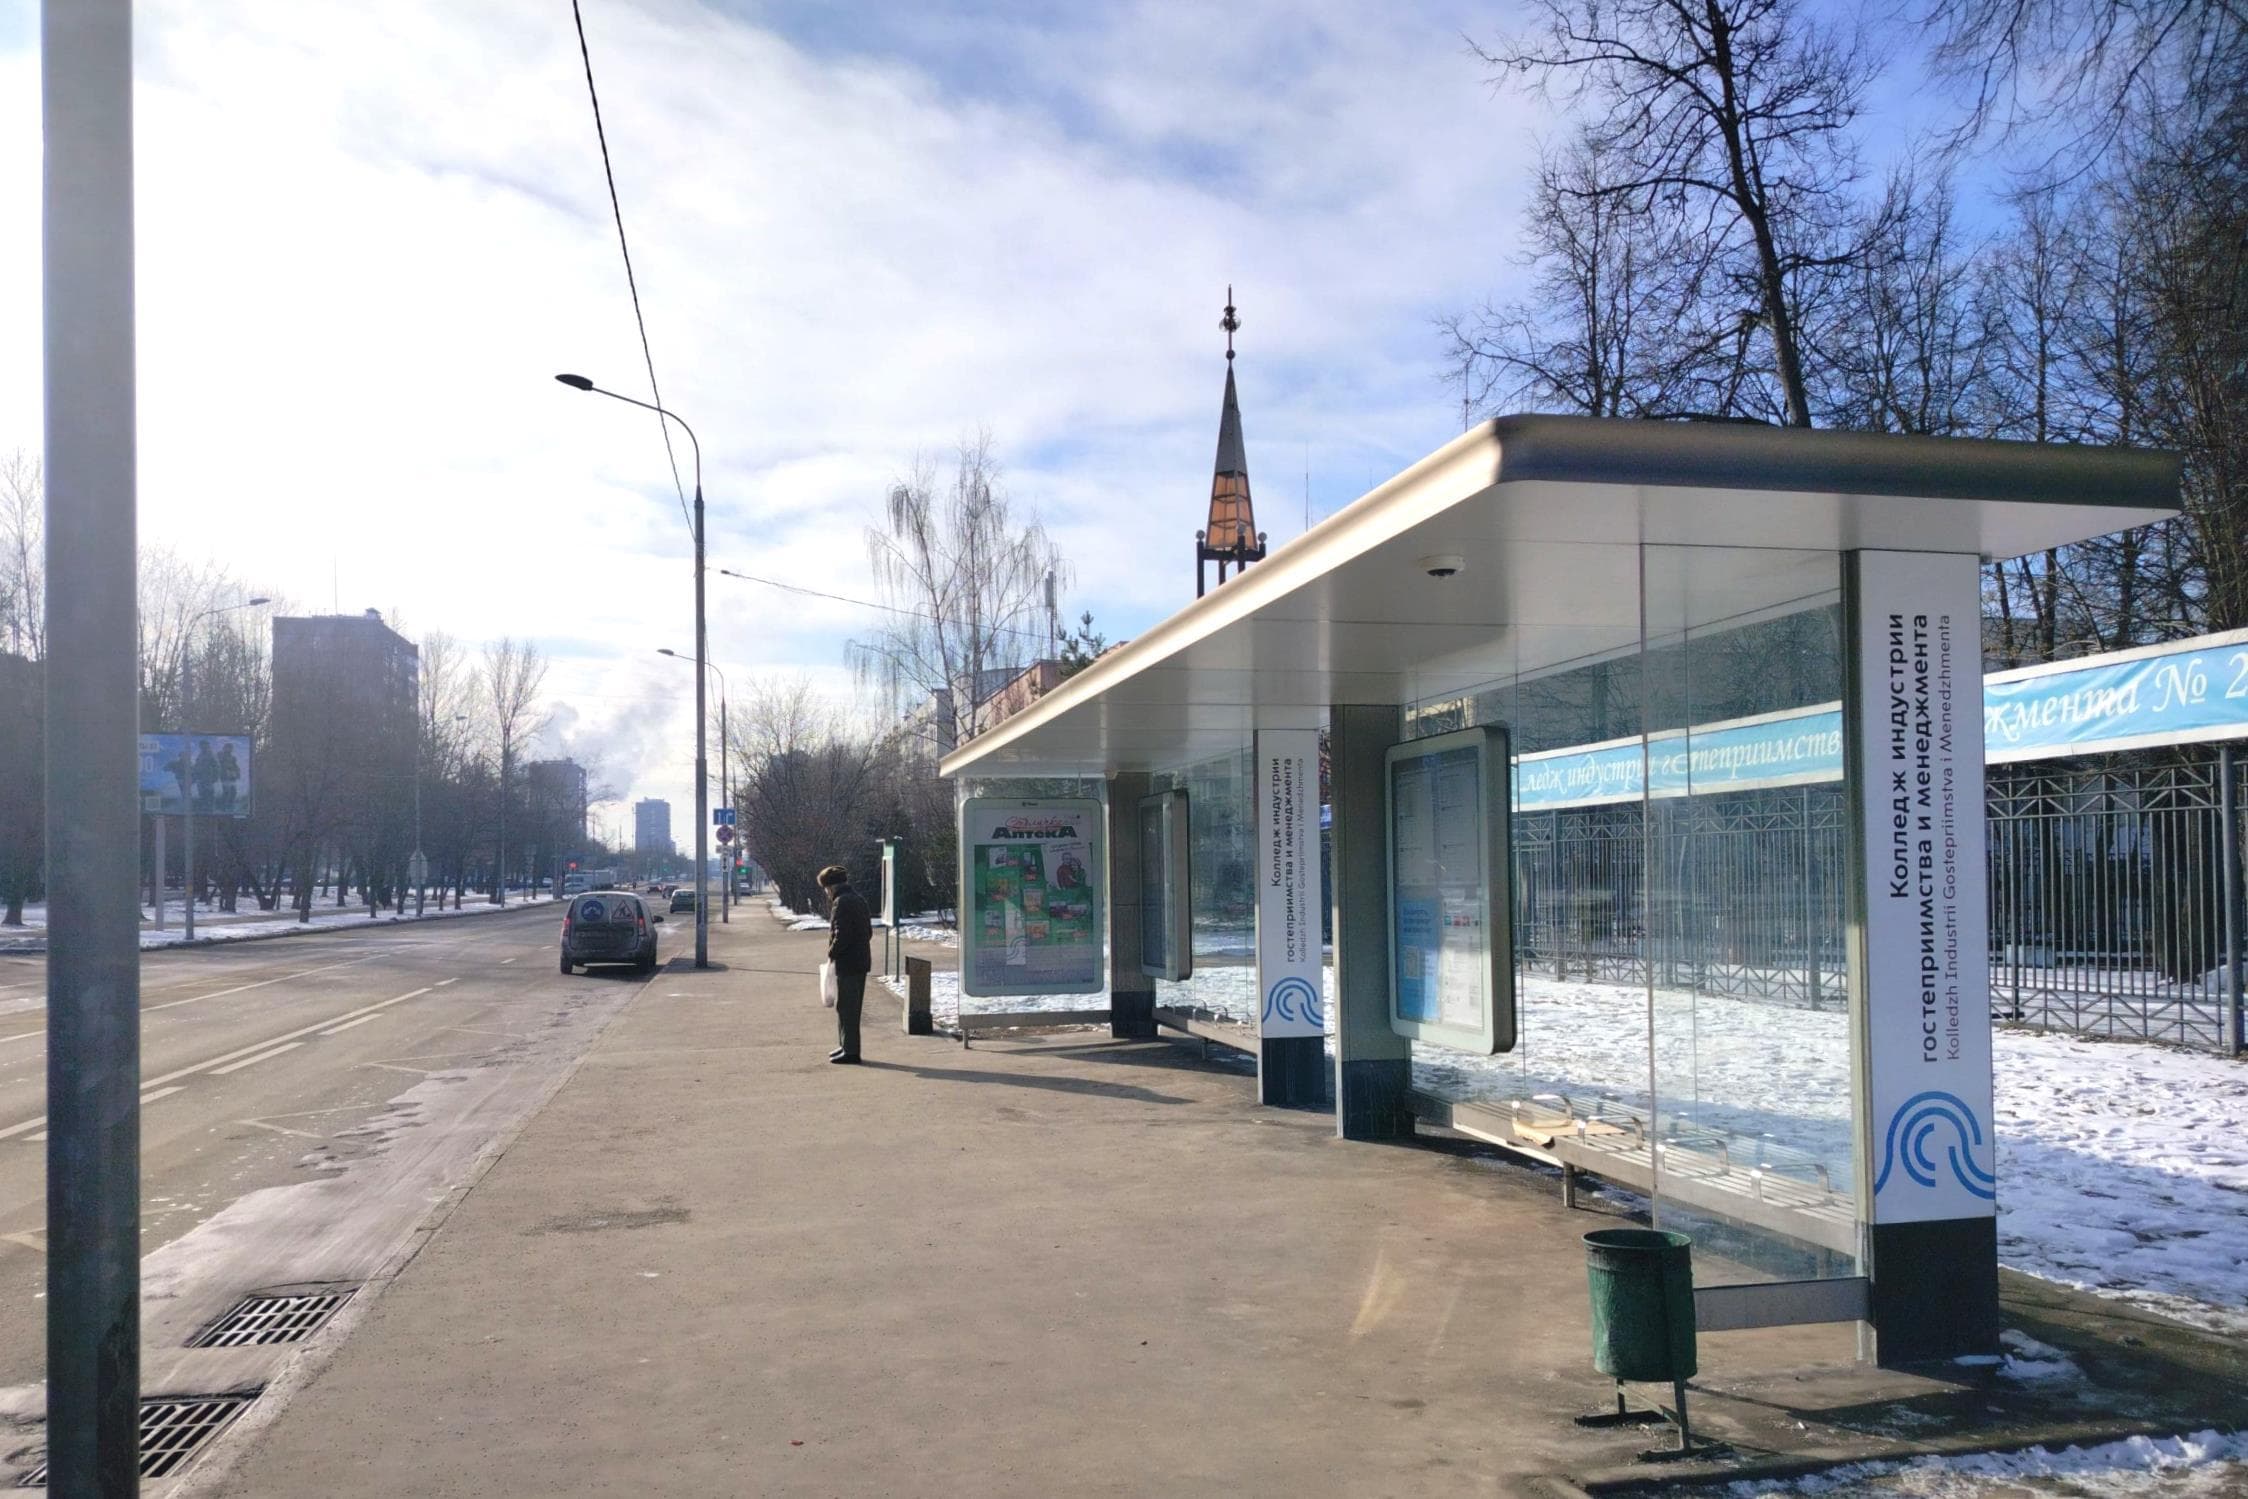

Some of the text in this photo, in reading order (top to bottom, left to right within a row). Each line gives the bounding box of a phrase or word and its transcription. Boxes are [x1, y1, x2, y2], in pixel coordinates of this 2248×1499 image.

[1938, 615, 1952, 752] Menedzhmenta
[2152, 658, 2207, 712] №
[1889, 614, 1910, 898] Колледж индустрии
[1271, 758, 1282, 887] Колледж индустрии
[1284, 758, 1296, 963] гостеприимства и менеджмента
[1914, 615, 1939, 1062] гостеприимства и менеджмента
[1942, 768, 1957, 899] Gostepriimstva
[1944, 906, 1958, 980] Industrii
[1945, 985, 1959, 1060] Kolledzh
